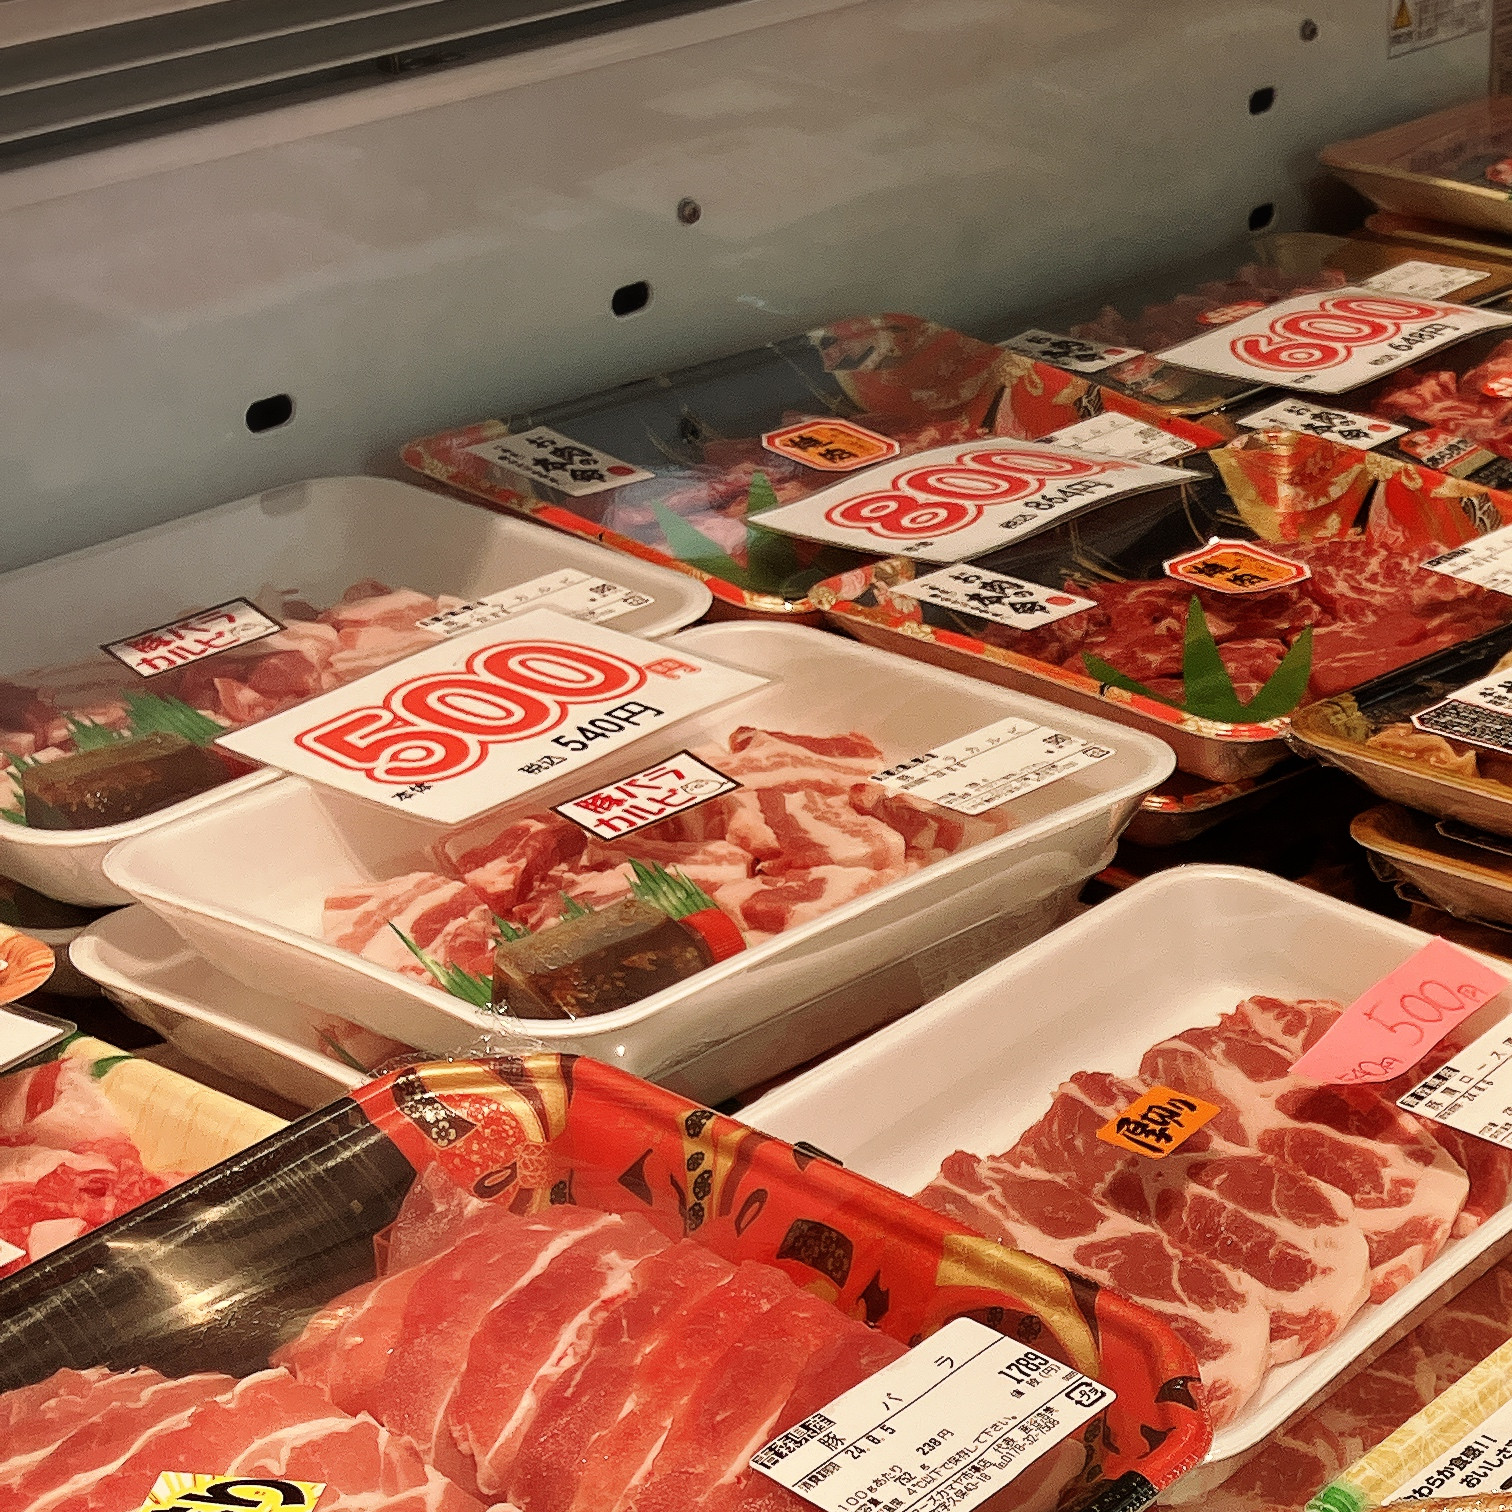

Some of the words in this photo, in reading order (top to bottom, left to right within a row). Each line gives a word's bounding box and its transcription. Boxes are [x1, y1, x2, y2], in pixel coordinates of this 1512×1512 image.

[551, 699, 665, 753] 540円
[575, 765, 687, 814] 豚バラ
[593, 784, 697, 834] カルビ
[997, 1350, 1049, 1384] 1789
[816, 1355, 954, 1451] 豚バラ
[914, 1427, 954, 1456] 238円
[892, 1470, 917, 1487] 752
